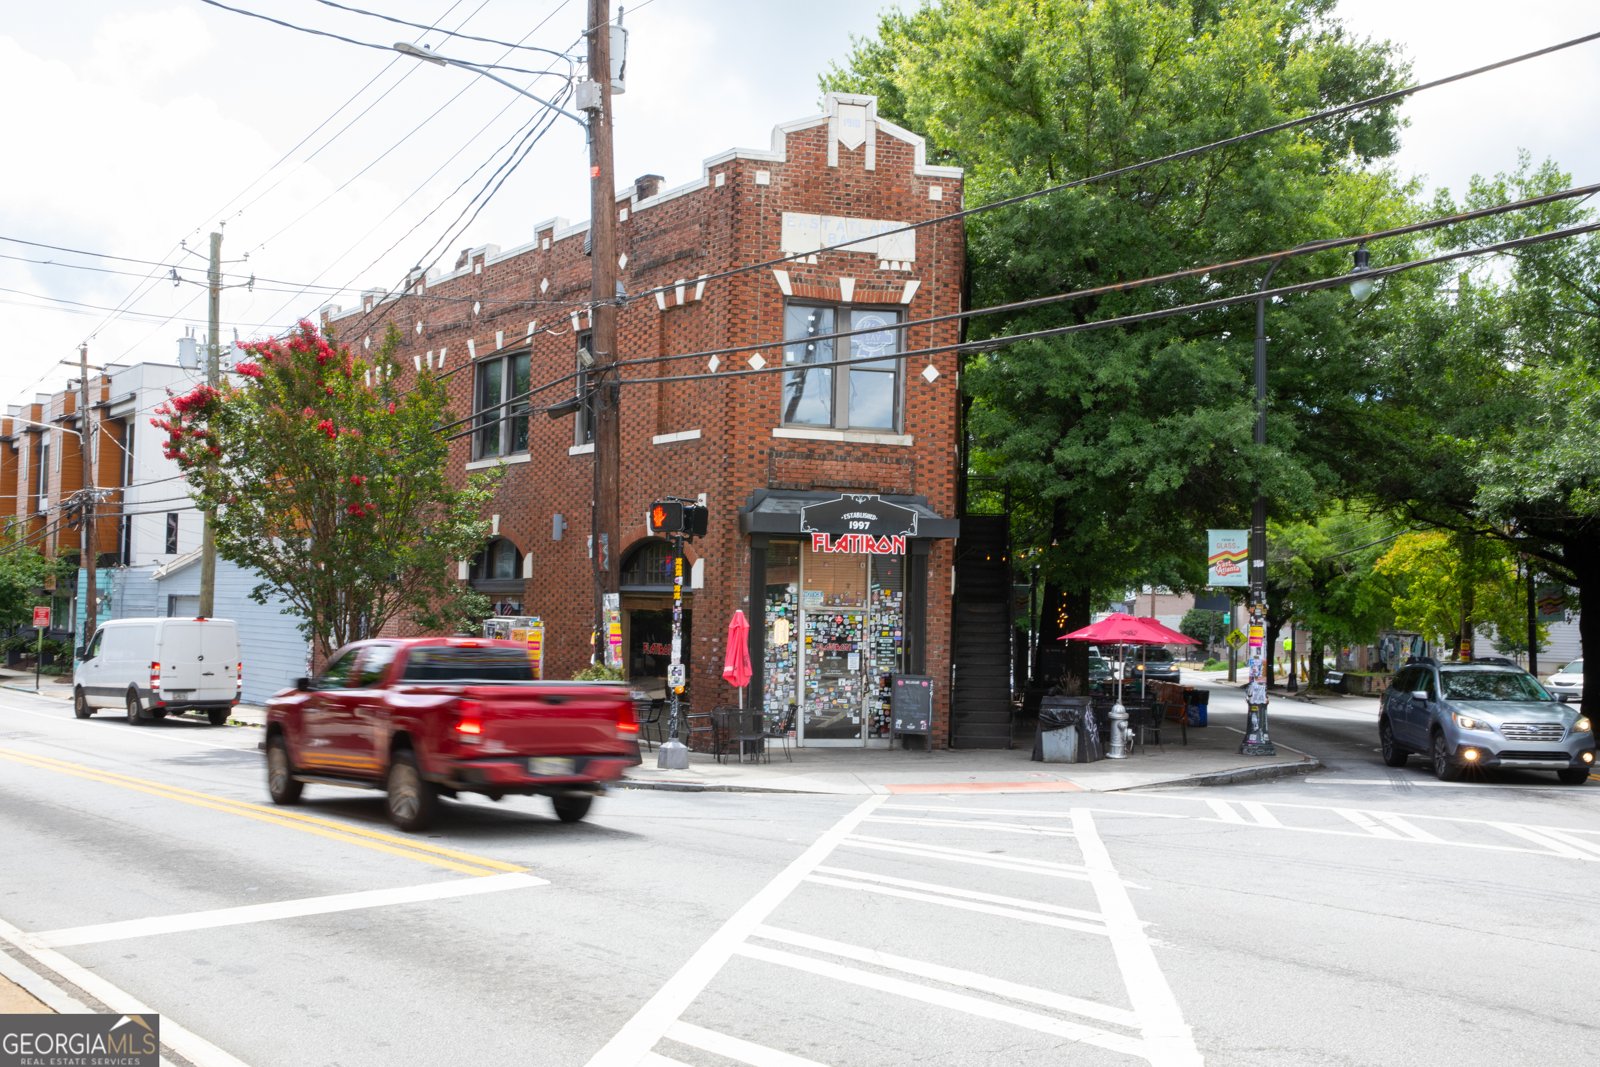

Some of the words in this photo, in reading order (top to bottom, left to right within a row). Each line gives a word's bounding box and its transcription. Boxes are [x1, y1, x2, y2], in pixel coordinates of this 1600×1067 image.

[786, 215, 831, 230] EAST
[849, 521, 870, 530] 1997
[811, 533, 906, 555] FLATIRON
